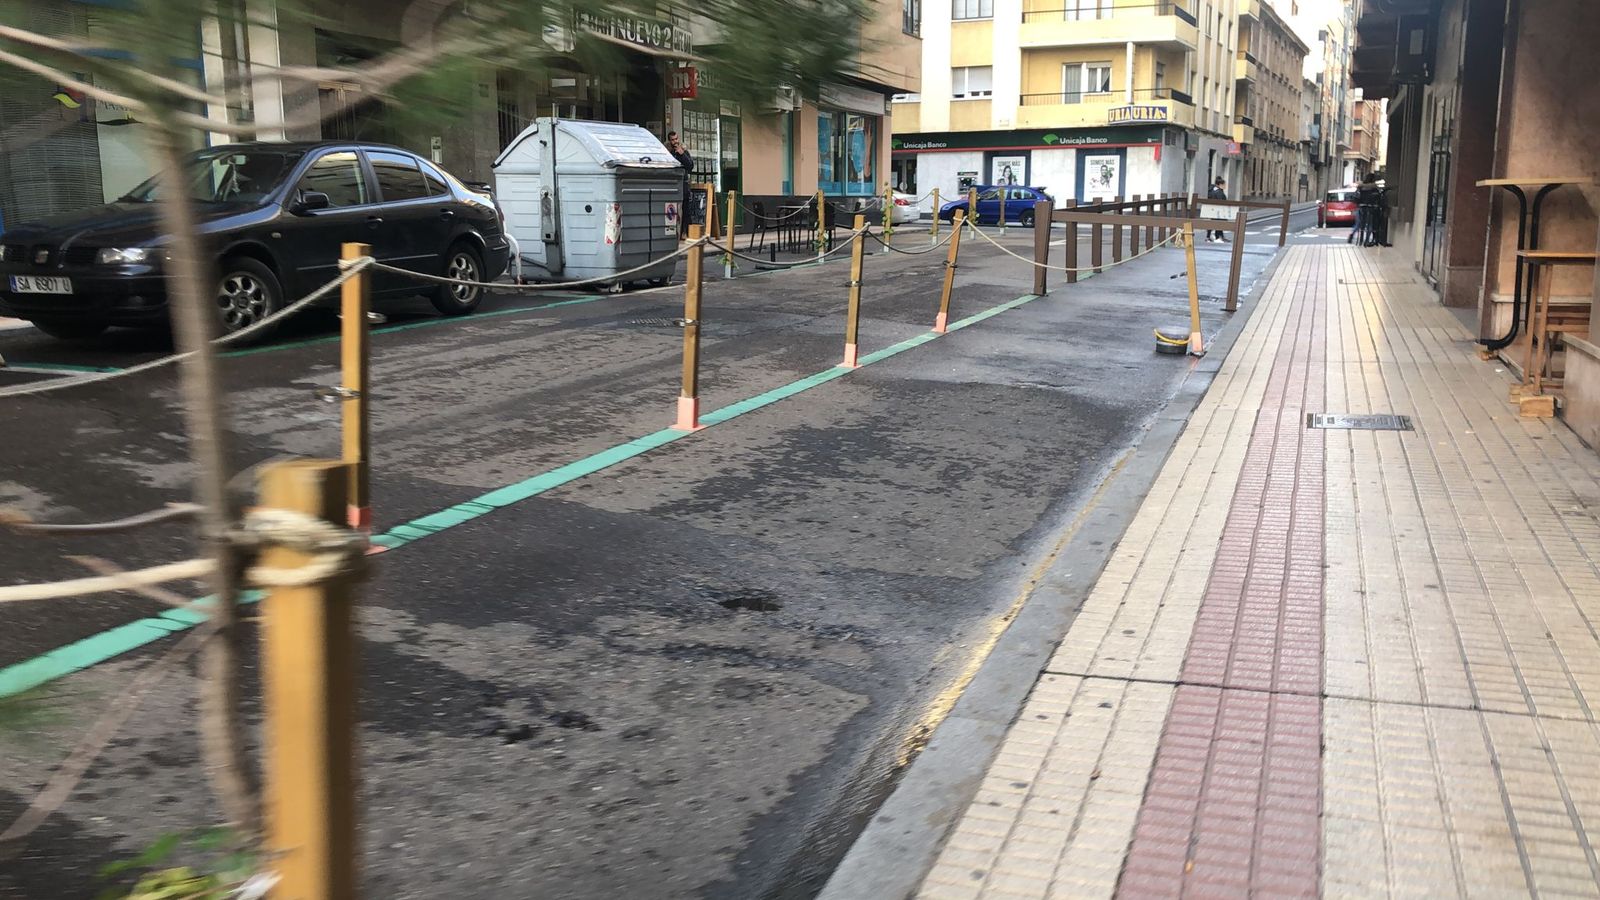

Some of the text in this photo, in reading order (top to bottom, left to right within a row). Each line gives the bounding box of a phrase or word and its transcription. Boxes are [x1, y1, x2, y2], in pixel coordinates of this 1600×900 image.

[617, 17, 662, 46] NUEVO
[663, 26, 672, 48] 2
[17, 276, 31, 290] SA
